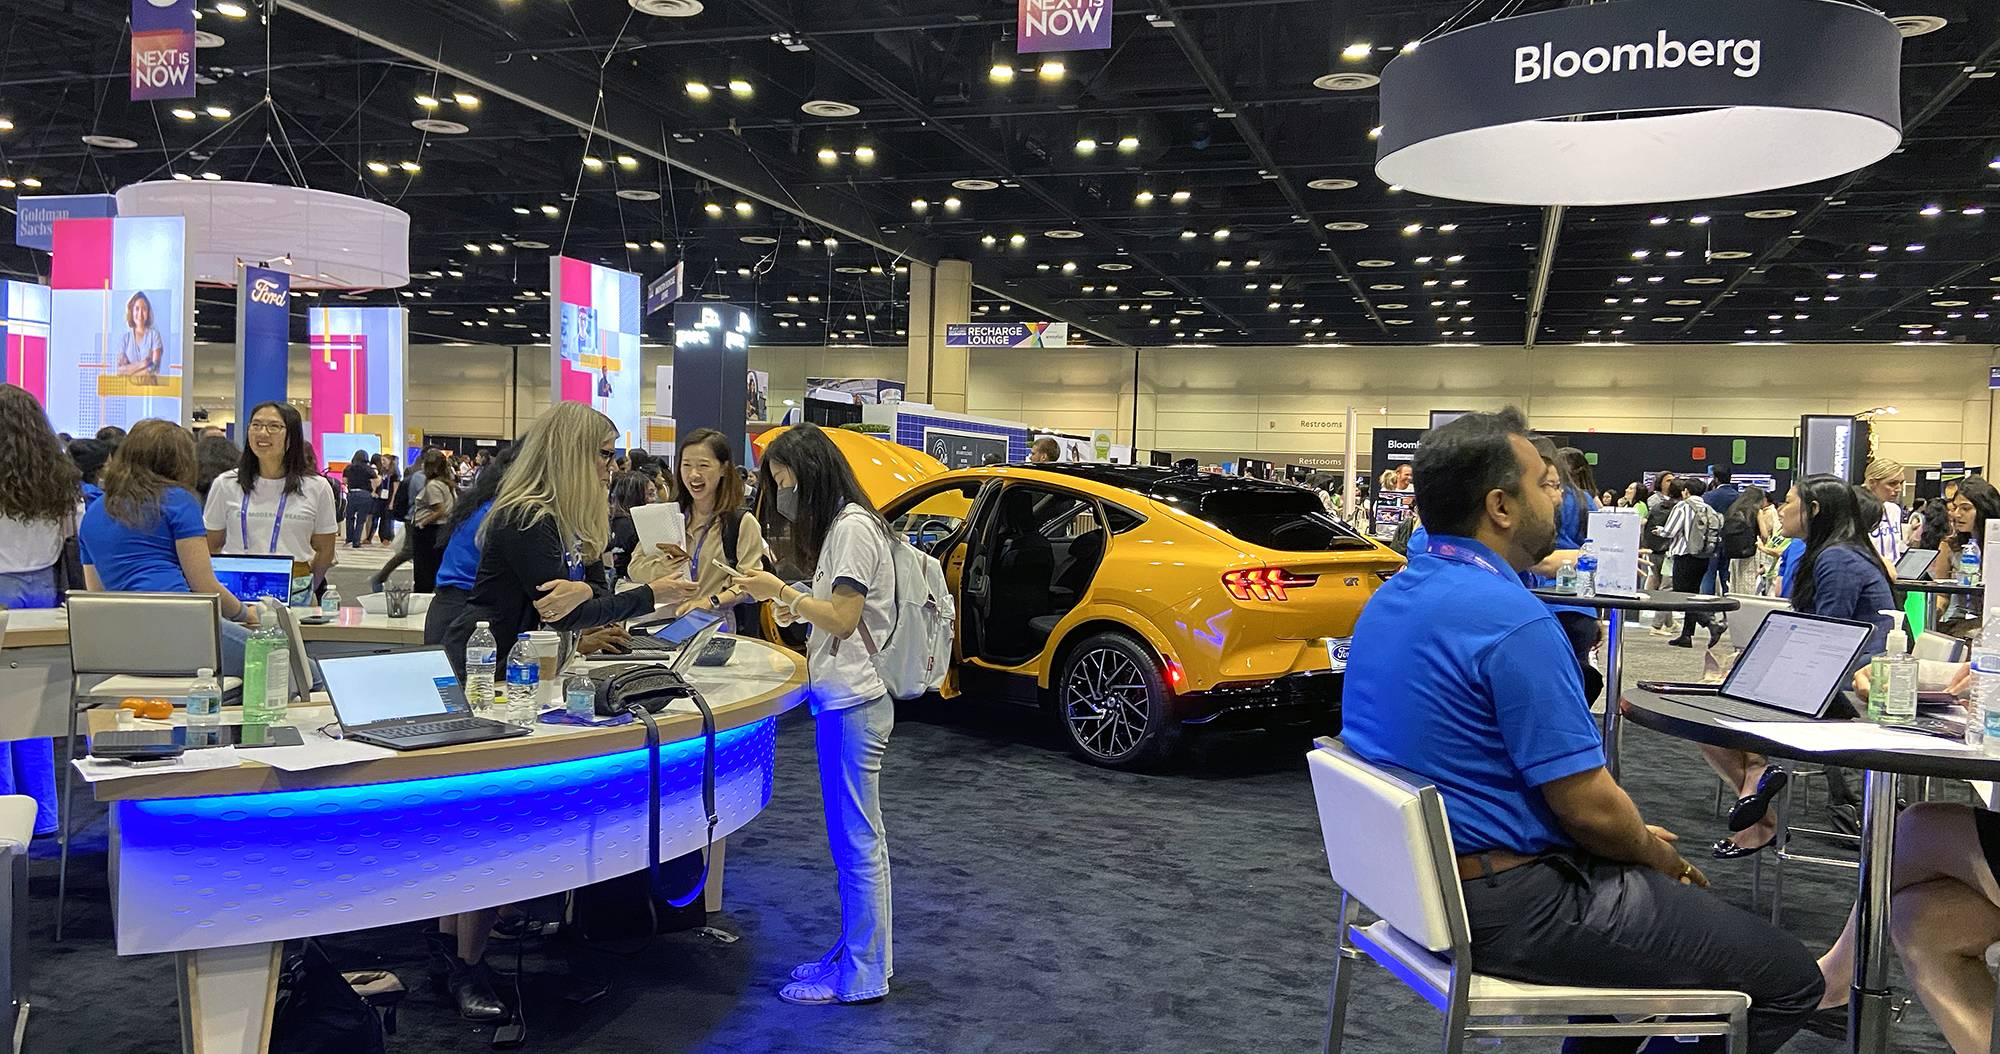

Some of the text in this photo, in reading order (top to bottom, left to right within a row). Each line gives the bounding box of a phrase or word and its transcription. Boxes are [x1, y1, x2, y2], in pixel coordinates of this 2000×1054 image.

[1025, 7, 1103, 37] NOW
[136, 49, 190, 67] NEXT IS
[1514, 29, 1761, 84] Bloomberg
[136, 65, 189, 88] NOW
[20, 207, 69, 221] Goldman
[20, 221, 53, 236] Sachs
[251, 279, 287, 307] Ford
[967, 327, 1023, 336] RECHARGE
[967, 336, 1010, 345] LOUNGE
[1300, 420, 1342, 428] Restrooms
[1298, 457, 1342, 466] Restrooms
[1605, 520, 1623, 529] Ford
